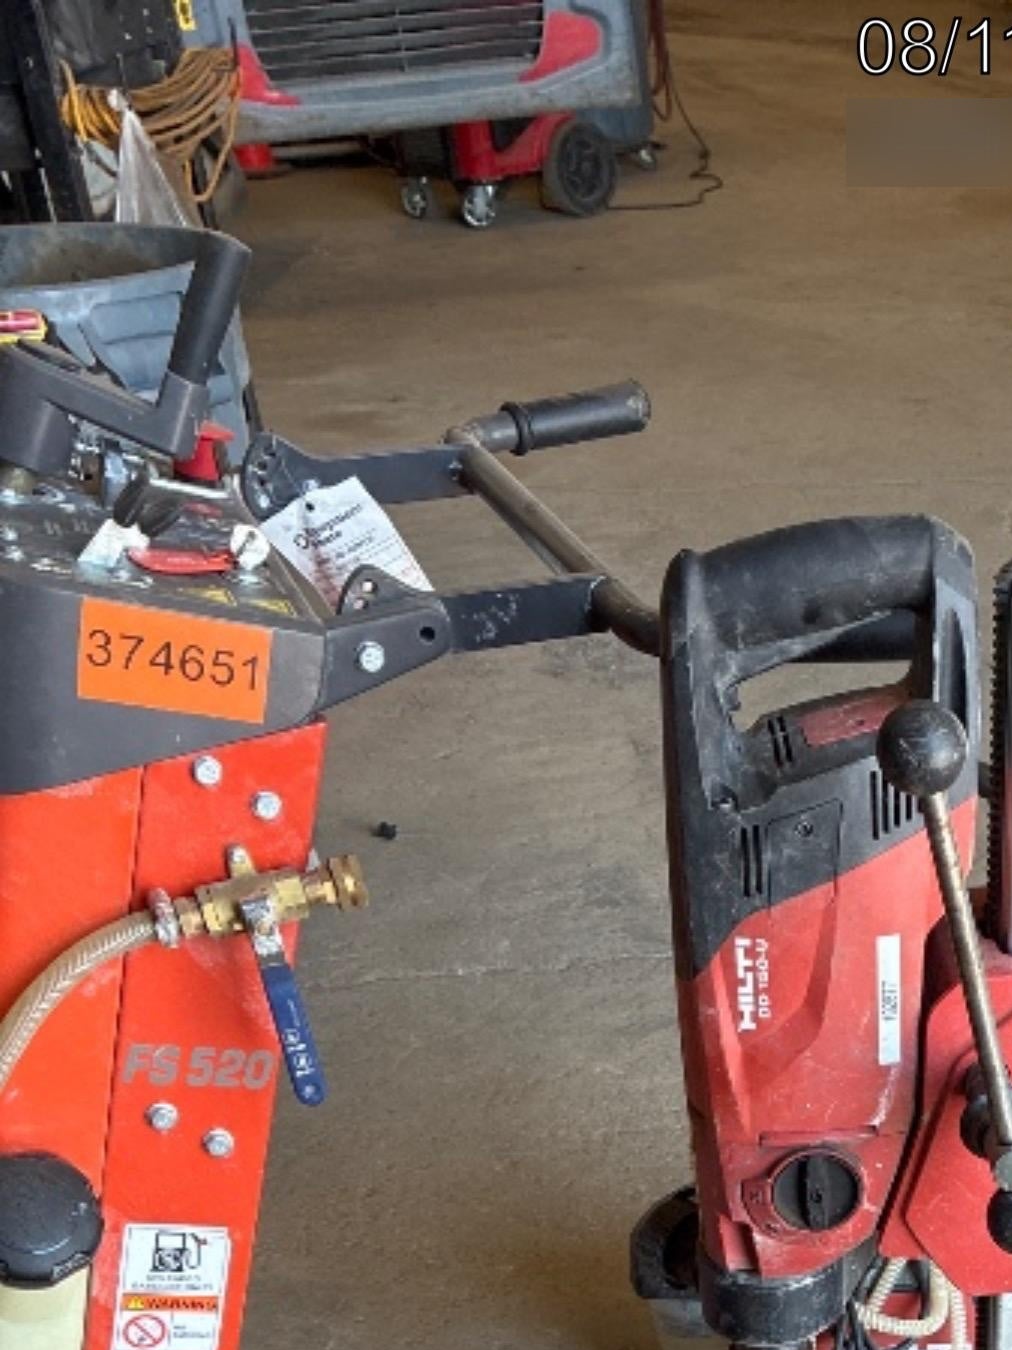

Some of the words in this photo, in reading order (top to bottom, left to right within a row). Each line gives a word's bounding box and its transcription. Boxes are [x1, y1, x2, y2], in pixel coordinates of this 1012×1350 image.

[85, 628, 259, 691] 374651
[734, 935, 757, 1033] HILTI
[122, 1043, 180, 1087] FS
[185, 1046, 274, 1089] 520
